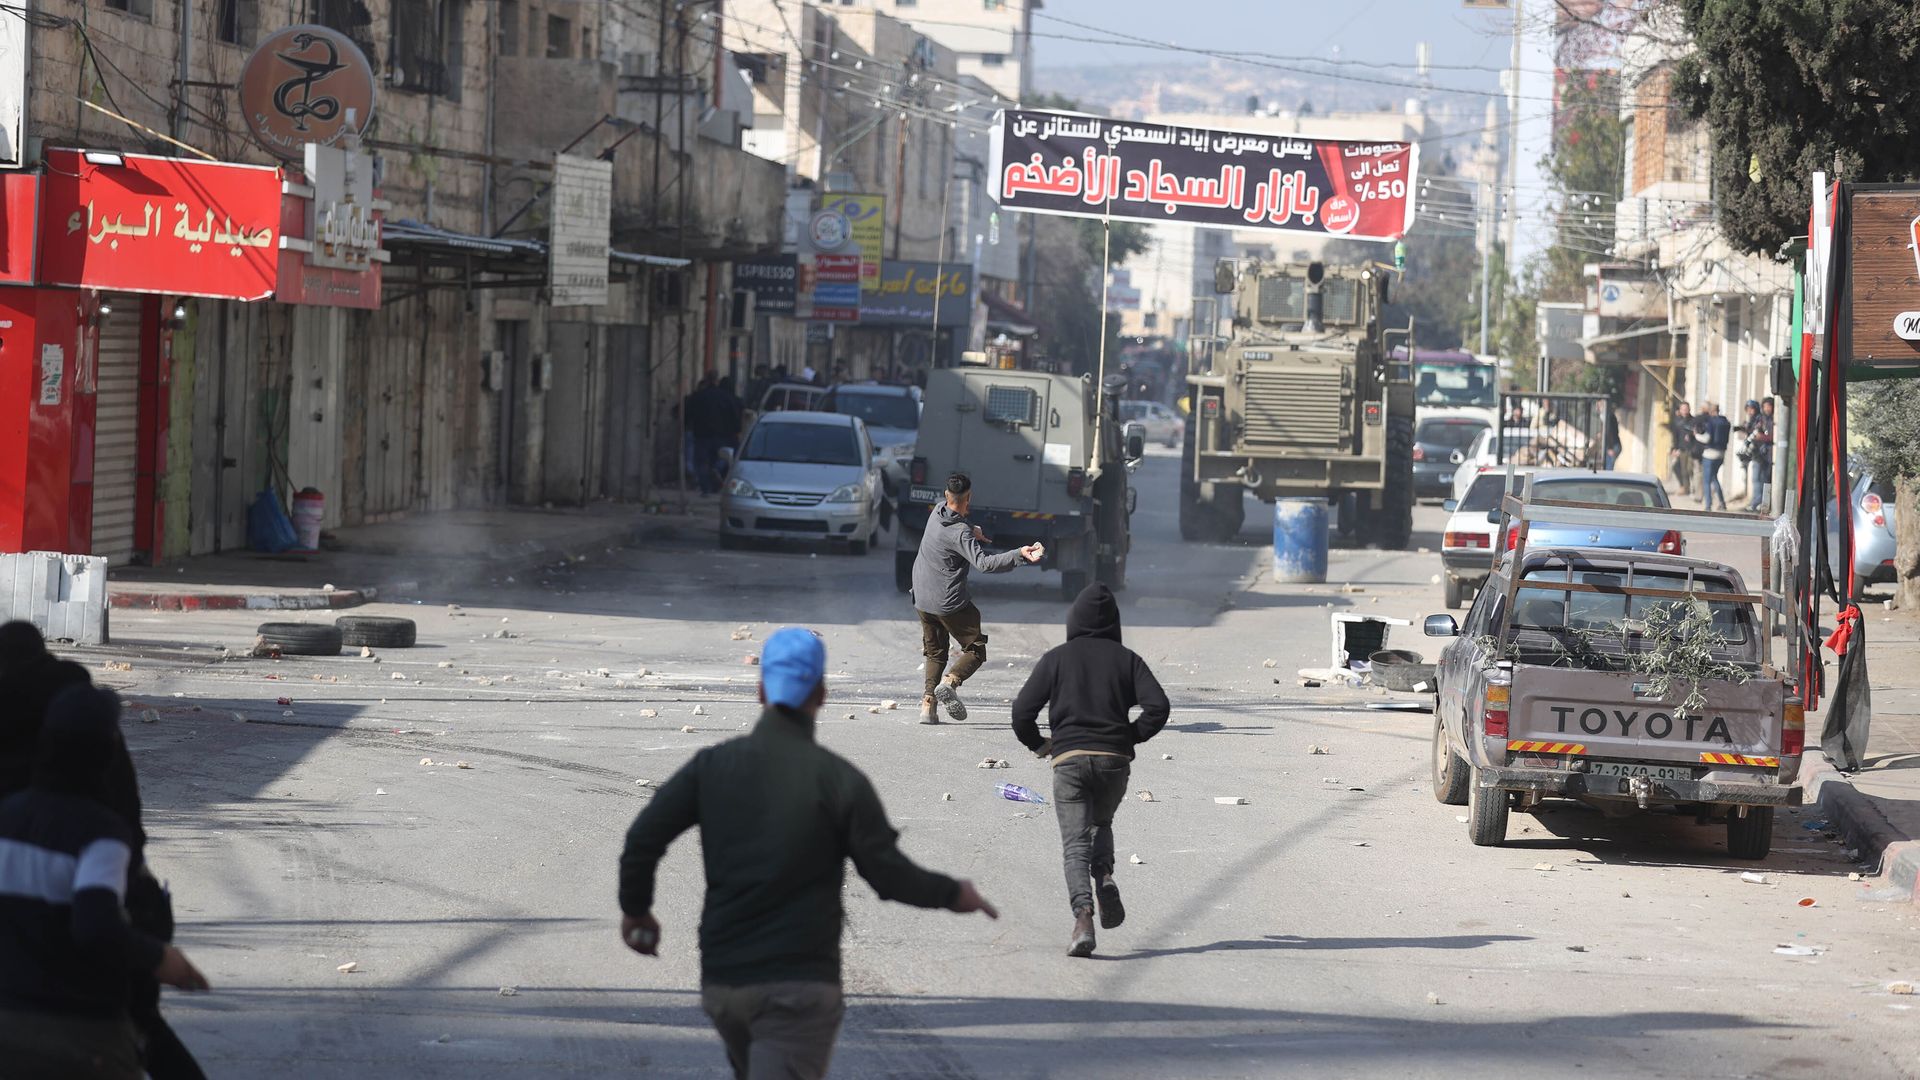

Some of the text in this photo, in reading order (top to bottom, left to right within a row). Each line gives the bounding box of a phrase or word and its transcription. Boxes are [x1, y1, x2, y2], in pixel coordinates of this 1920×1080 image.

[1012, 114, 1038, 138] عن
[1038, 115, 1101, 141] للستائر
[1103, 123, 1177, 149] السعدي
[1212, 131, 1270, 155] معرض
[1272, 136, 1313, 161] يعلن
[1372, 159, 1401, 177] تصل
[1002, 146, 1320, 226] بازار السجاد الأضخم
[66, 199, 273, 257] صيدلية البراء
[736, 263, 796, 280] ESPRESSO
[1550, 706, 1734, 744] TOYOTA
